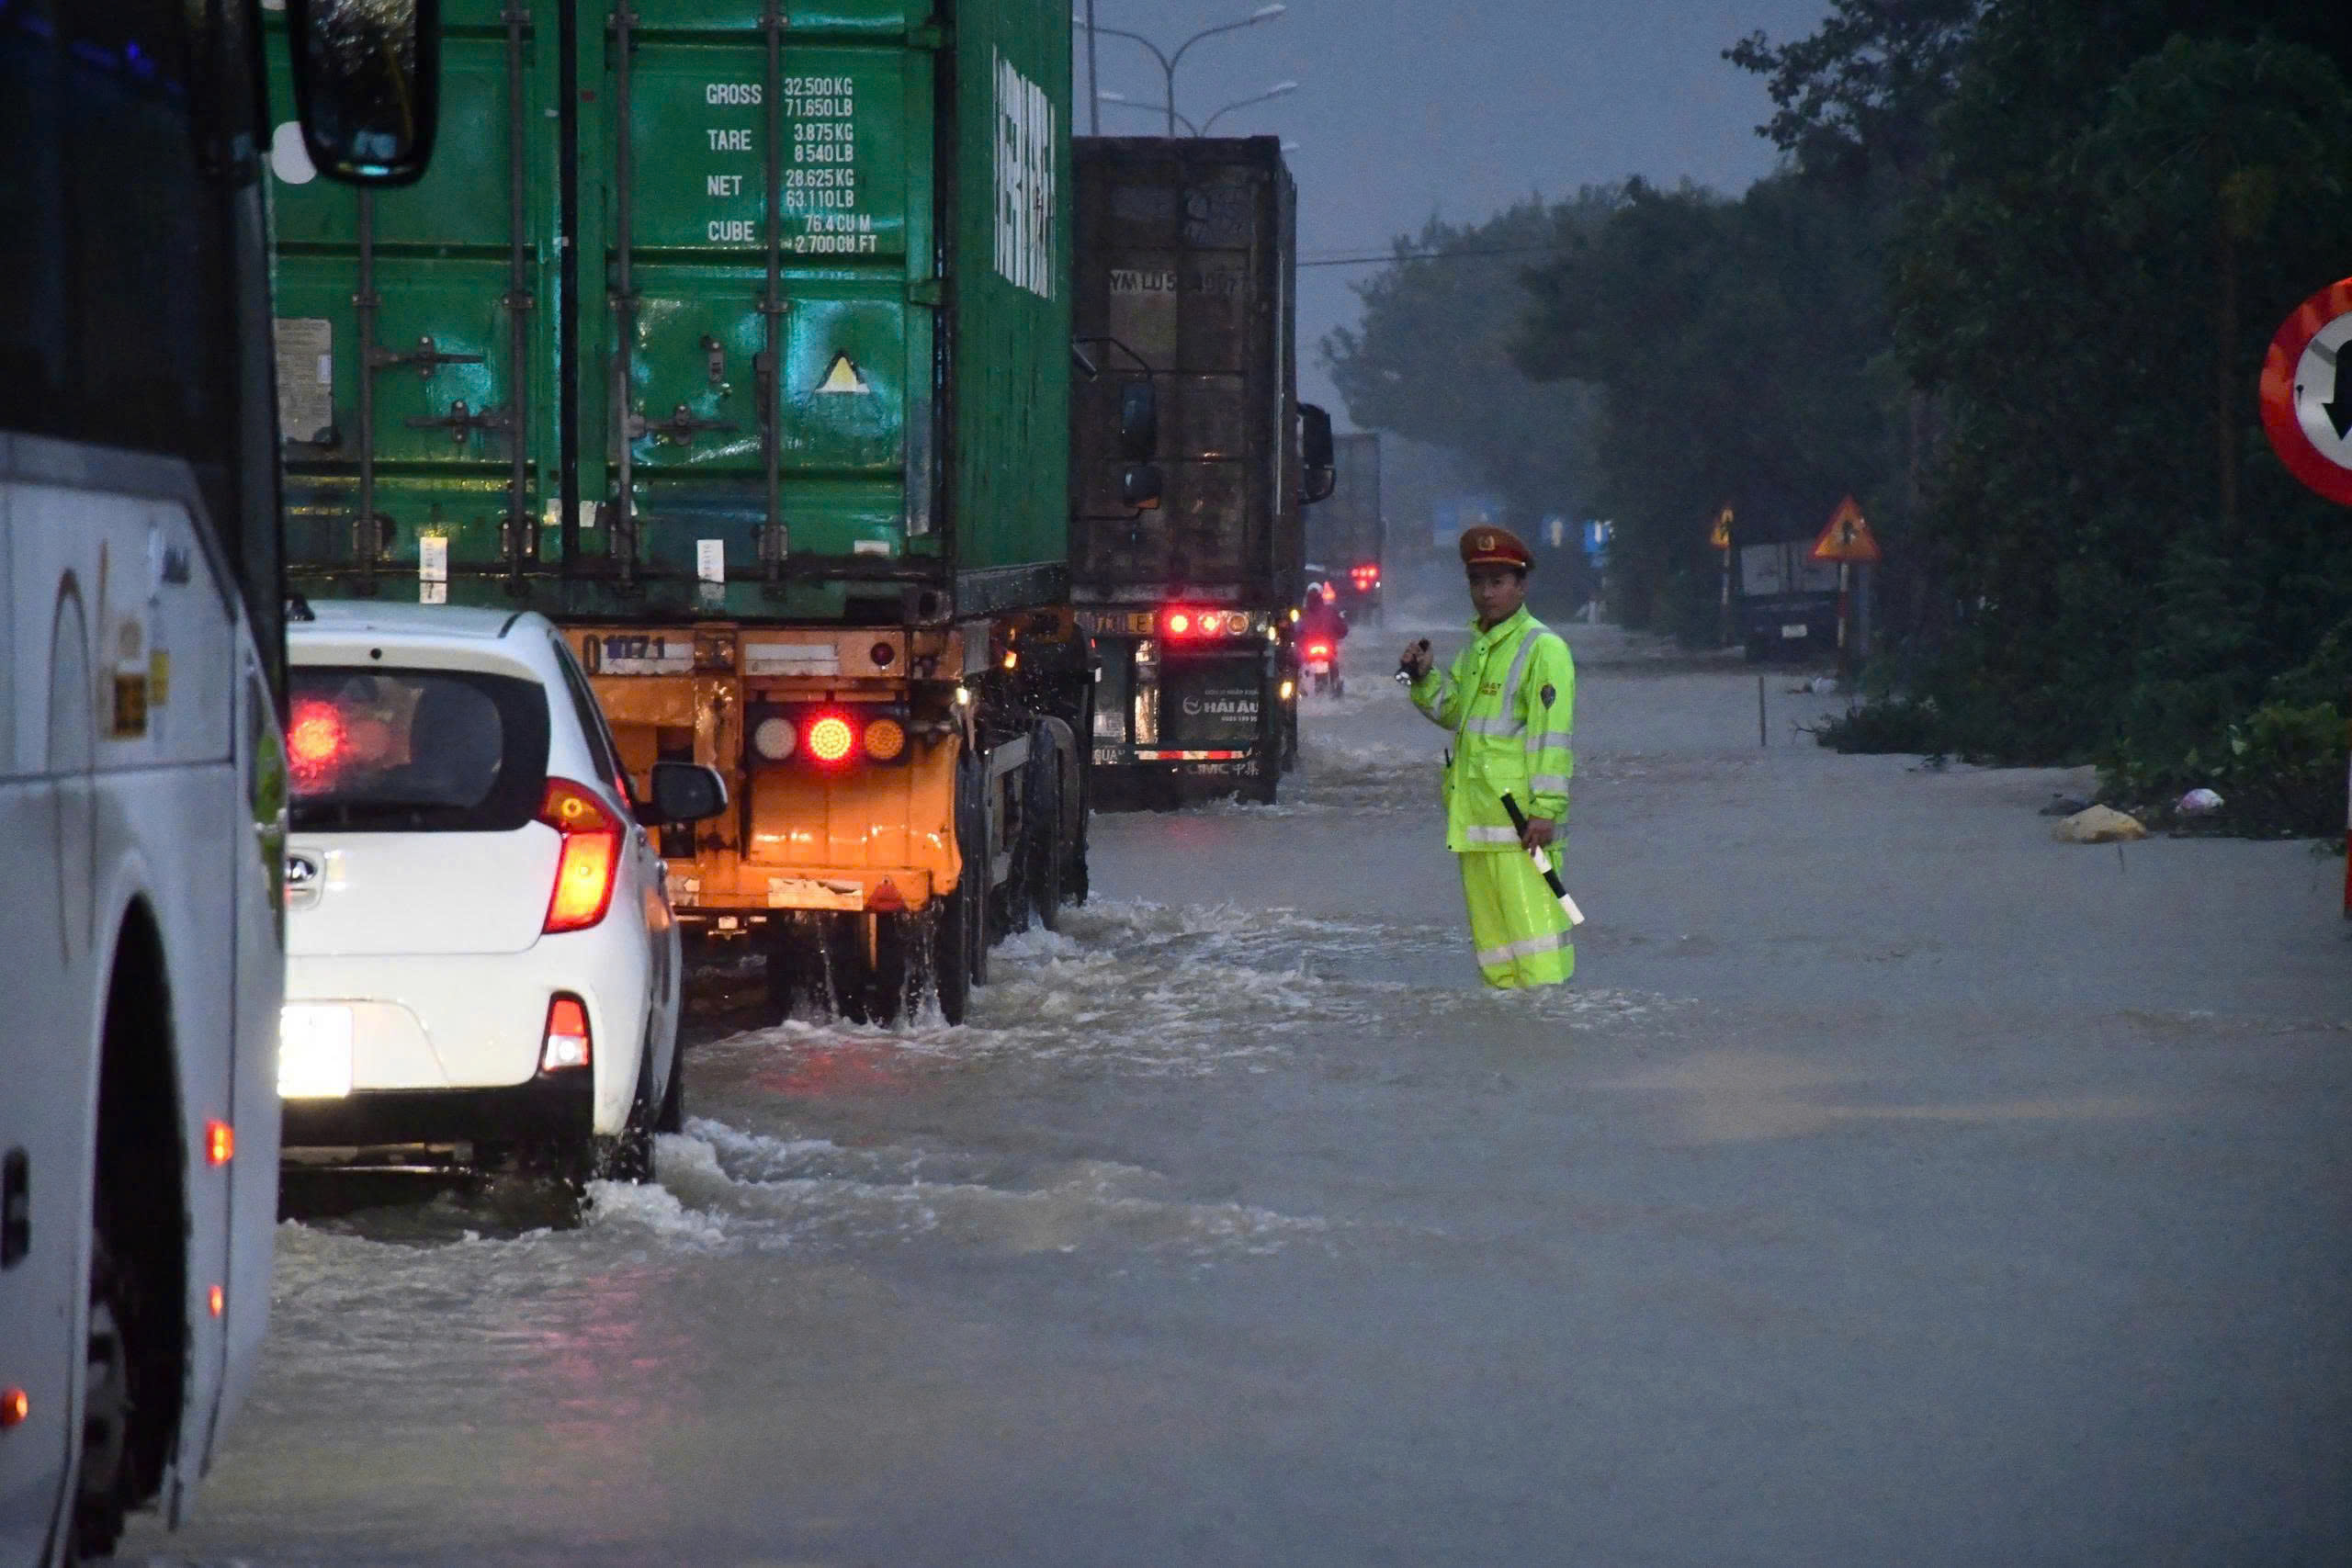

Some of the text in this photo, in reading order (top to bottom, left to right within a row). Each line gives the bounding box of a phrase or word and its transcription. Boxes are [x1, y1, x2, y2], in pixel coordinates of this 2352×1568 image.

[707, 84, 762, 105] GROSS
[834, 78, 853, 96] KG
[835, 98, 853, 117] LB
[707, 130, 752, 151] TARE
[835, 123, 854, 141] KG
[836, 144, 854, 162] LB
[707, 175, 742, 196] NET
[836, 169, 854, 186] KG
[837, 190, 854, 208] LB
[707, 220, 754, 242] CUBE
